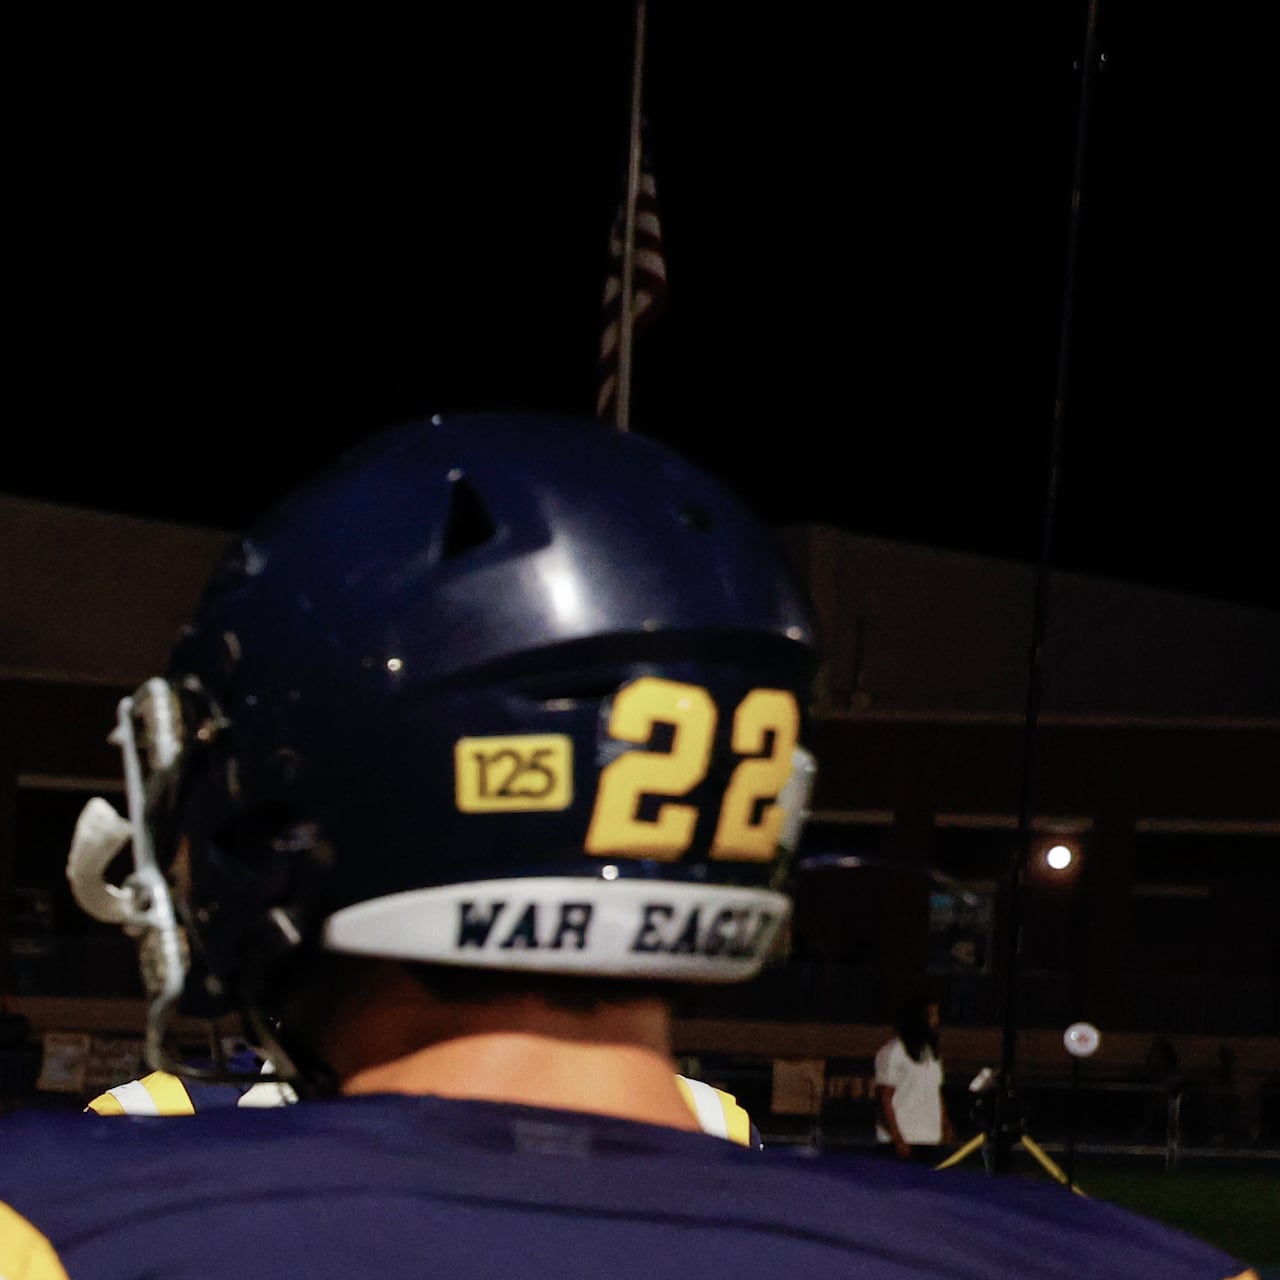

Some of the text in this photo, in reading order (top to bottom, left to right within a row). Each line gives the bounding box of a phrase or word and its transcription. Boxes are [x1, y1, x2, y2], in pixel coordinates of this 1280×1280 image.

[472, 747, 557, 800] 125
[584, 676, 800, 863] 22
[456, 902, 594, 951] WAR
